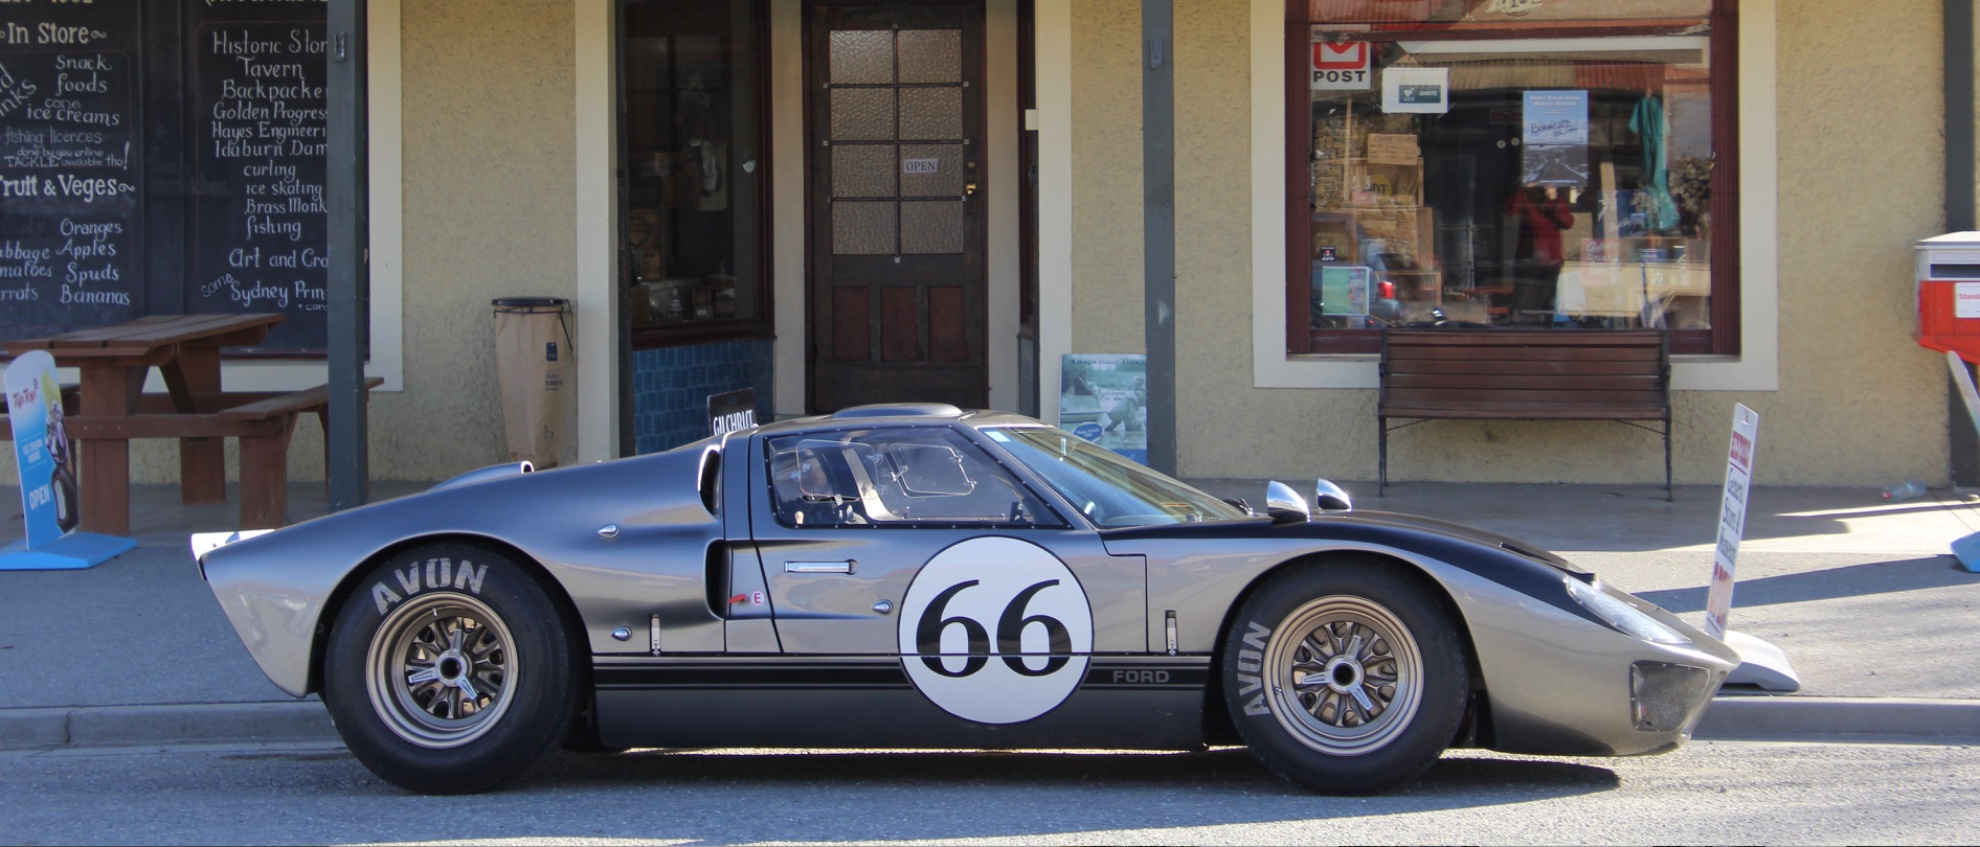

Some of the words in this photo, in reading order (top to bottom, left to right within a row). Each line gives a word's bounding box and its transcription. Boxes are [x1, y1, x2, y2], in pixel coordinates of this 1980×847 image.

[7, 22, 29, 44] In
[38, 22, 89, 44] Store
[212, 29, 282, 54] Historic
[55, 54, 112, 71] Snack
[235, 55, 306, 79] Tavern
[55, 71, 108, 96] foods
[1313, 70, 1366, 83] POST
[221, 78, 328, 102] Backpacke
[27, 103, 52, 120] ice
[56, 108, 120, 126] creams
[44, 98, 81, 110] cone
[213, 100, 270, 120] Golden
[5, 126, 44, 146] fishing
[50, 126, 102, 144] licences
[210, 121, 253, 145] Hayes
[214, 139, 283, 158] Idaburn
[4, 155, 59, 168] TACKLE
[61, 158, 102, 167] available
[243, 159, 297, 184] curling
[906, 160, 936, 171] OPEN
[43, 179, 57, 196] &
[57, 174, 117, 203] Veges
[246, 184, 266, 196] ice
[271, 179, 323, 201] skating
[243, 198, 287, 216] Brass
[60, 217, 122, 242] Oranges
[246, 215, 301, 242] fishing
[0, 240, 50, 264] bbage
[56, 238, 117, 260] Apples
[229, 246, 260, 269] Art
[269, 249, 297, 269] and
[65, 261, 119, 287] Spuds
[201, 272, 234, 298] some
[59, 284, 131, 306] Bananas
[230, 279, 289, 308] Sydney
[294, 279, 328, 301] Prin
[28, 483, 50, 511] OPEN
[370, 557, 490, 616] AVON
[754, 593, 761, 604] E
[916, 579, 1072, 678] 66
[1113, 670, 1170, 683] FORD
[1236, 620, 1274, 717] AVON
